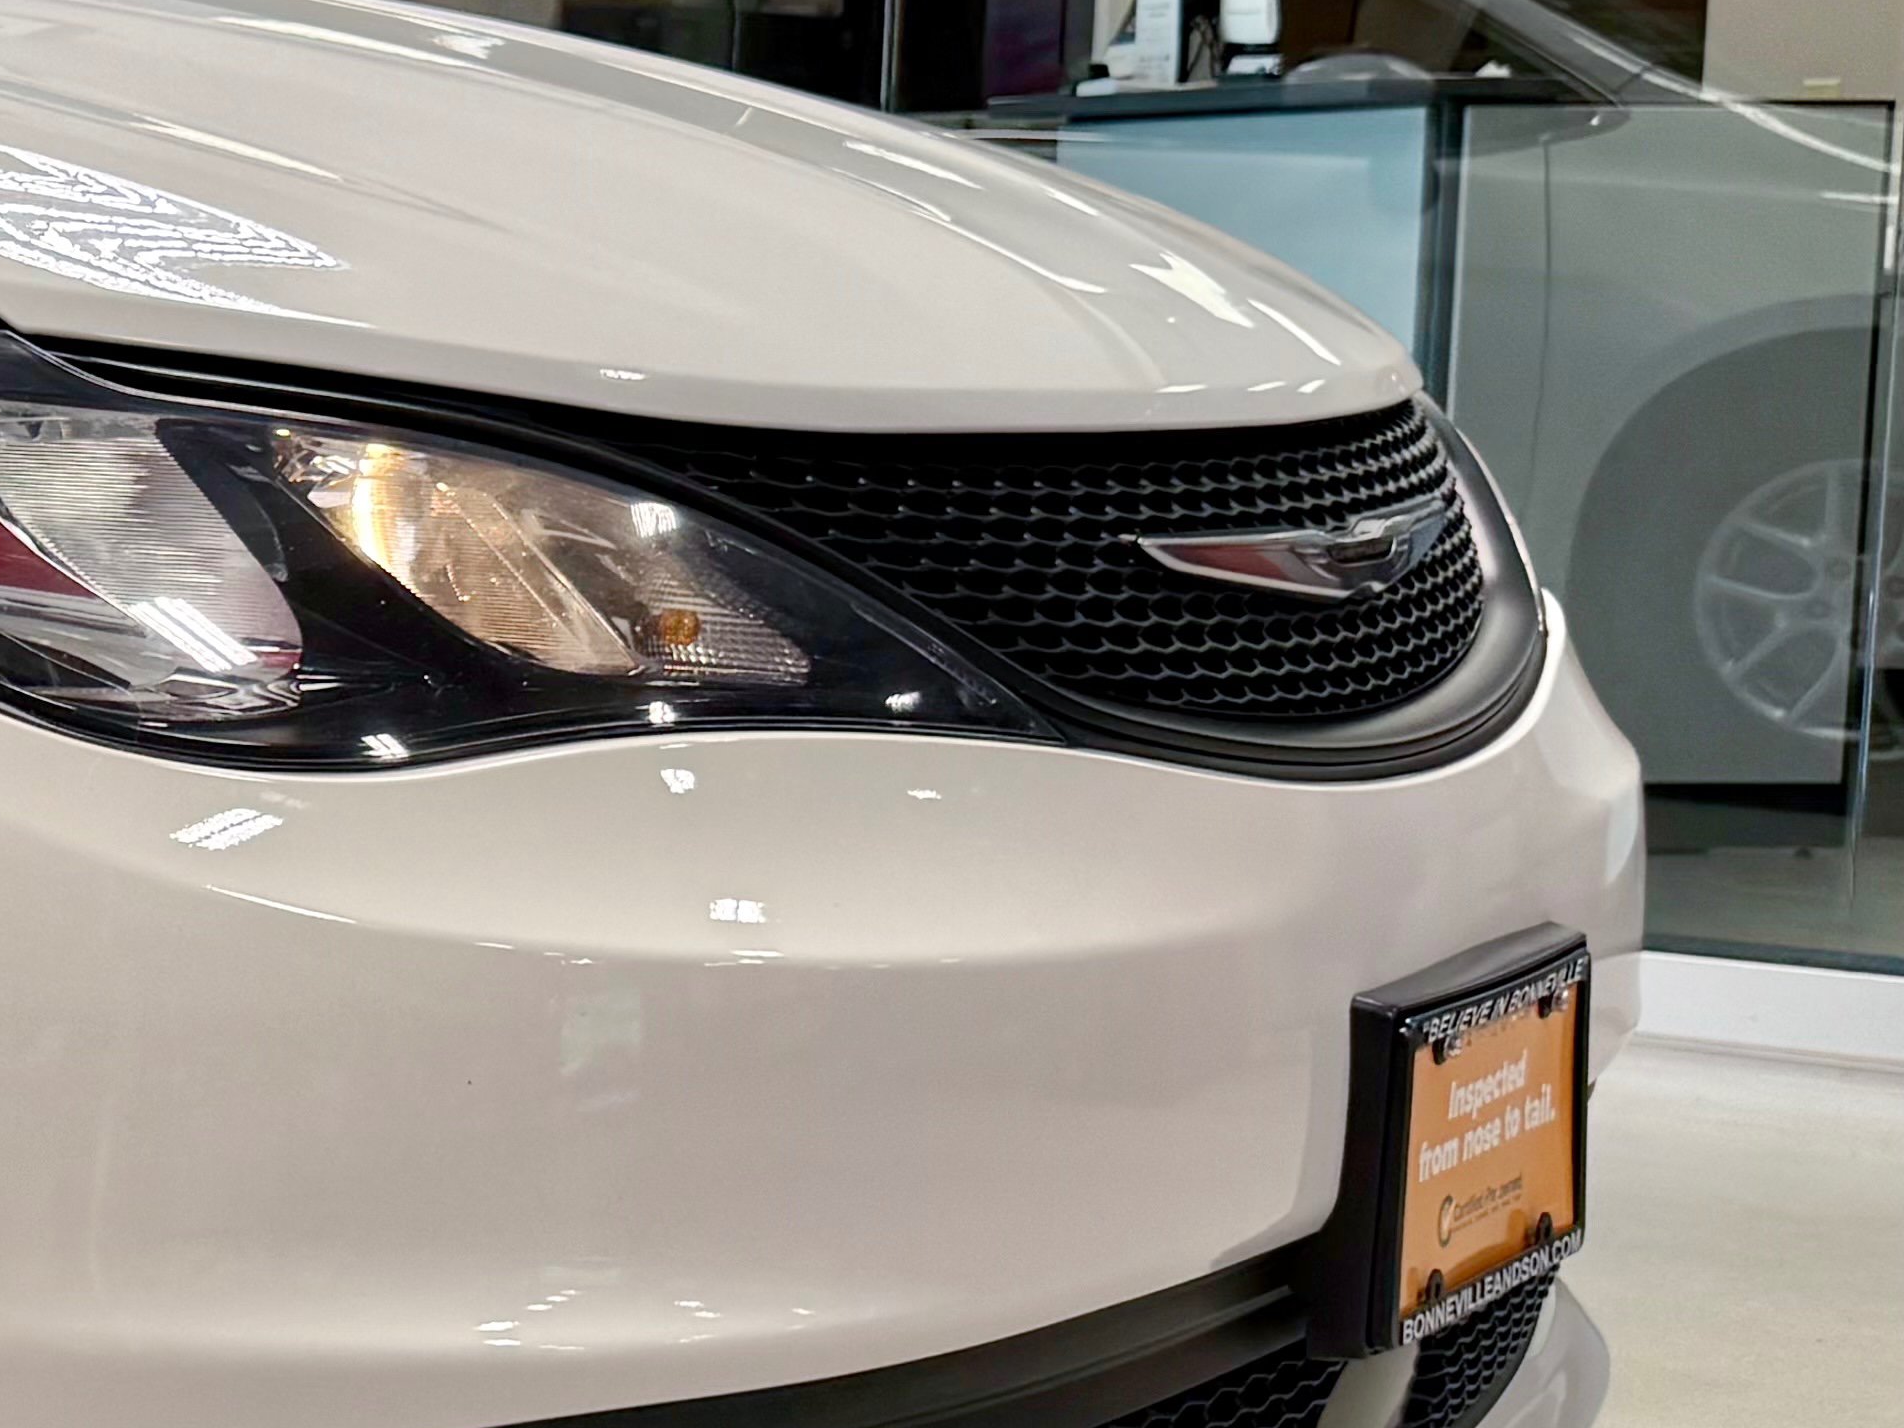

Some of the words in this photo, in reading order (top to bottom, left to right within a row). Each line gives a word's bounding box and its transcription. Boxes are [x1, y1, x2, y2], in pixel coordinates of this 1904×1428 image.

[1419, 1138, 1459, 1182] from
[1463, 1117, 1501, 1162] nose
[1505, 1105, 1520, 1141] to
[1524, 1083, 1555, 1131] tail.
[1448, 1048, 1527, 1120] Inspected
[1403, 1229, 1582, 1345] BONNEVILLEANDSON.COM
